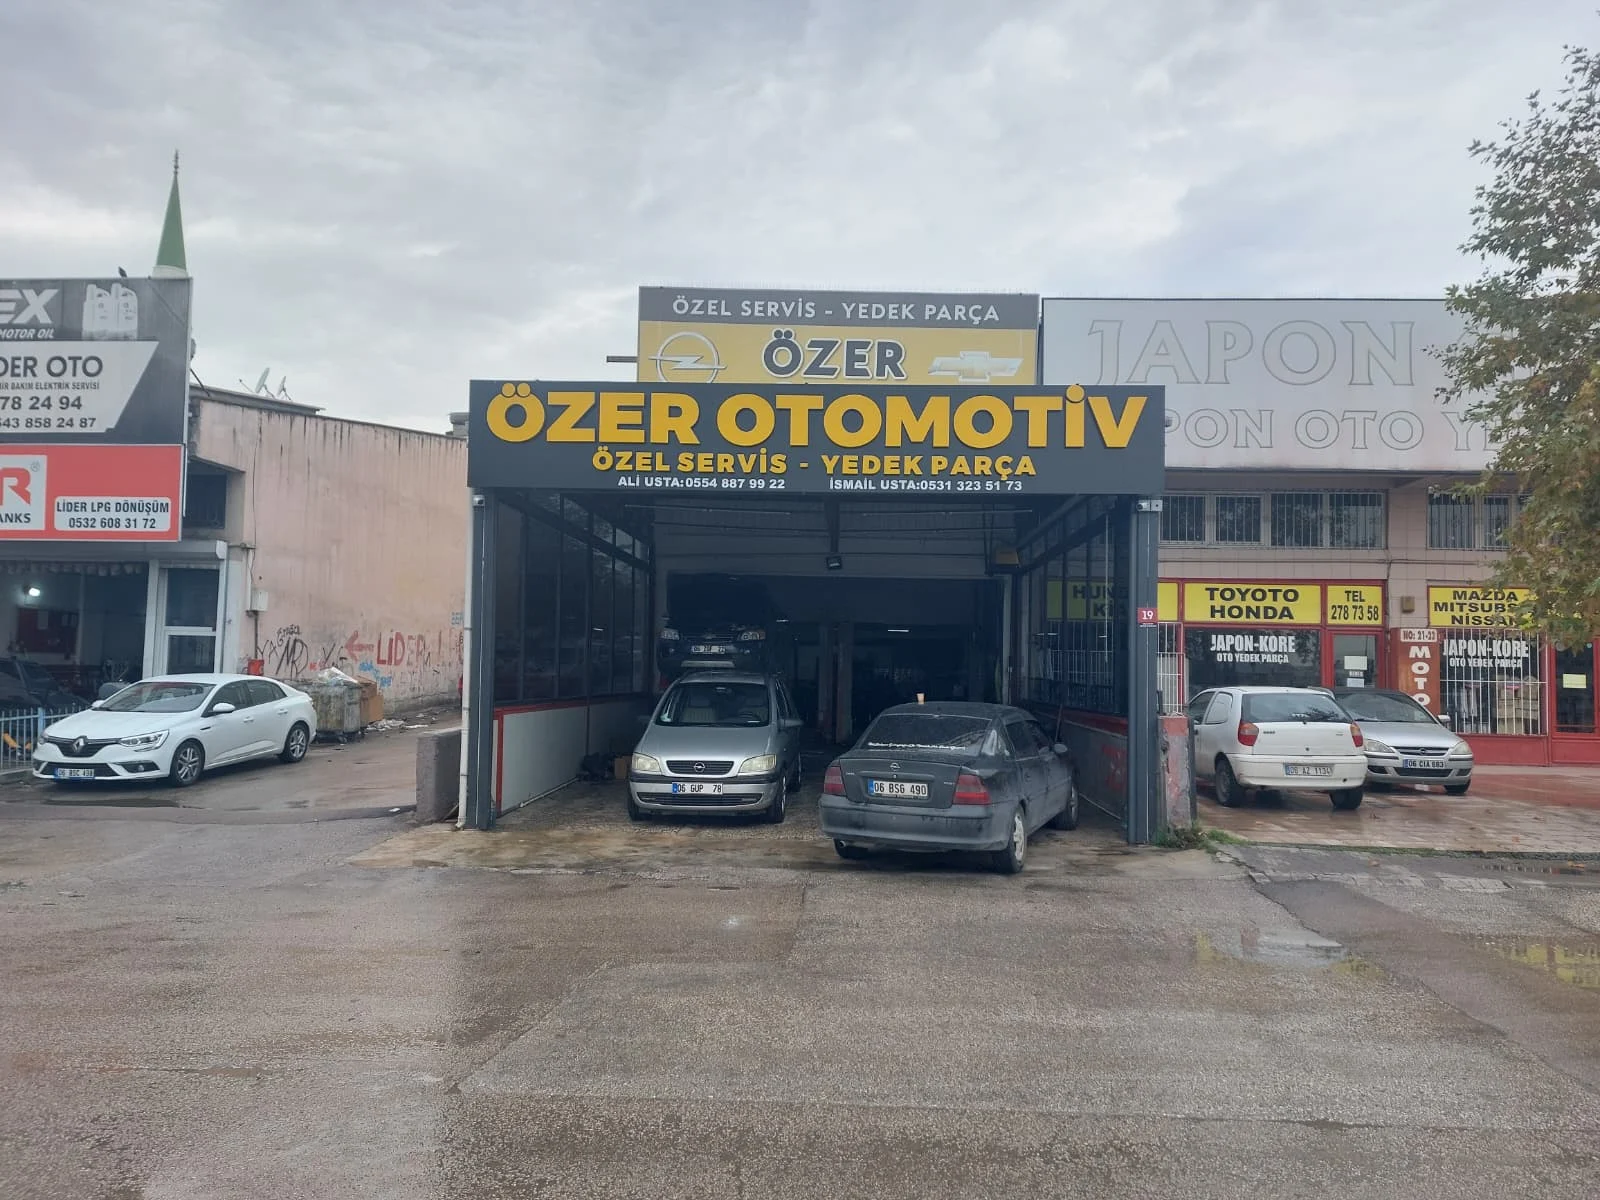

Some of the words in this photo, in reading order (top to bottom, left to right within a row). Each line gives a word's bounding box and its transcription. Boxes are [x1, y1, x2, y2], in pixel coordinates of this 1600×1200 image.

[672, 295, 732, 316] ÖZEL
[740, 297, 816, 319] SERVİS
[841, 302, 916, 321] YEDEK
[924, 304, 1000, 325] PARÇA
[762, 328, 907, 381] ÖZER
[1088, 320, 1415, 386] JAPON
[46, 355, 103, 377] OTO
[28, 396, 52, 410] 24
[59, 396, 82, 410] 94
[25, 417, 52, 428] 858
[56, 417, 74, 428] 24
[79, 417, 97, 428] 87
[486, 382, 701, 445] ÖZER
[716, 384, 1148, 449] OTOMOTİV
[1295, 408, 1425, 450] OTO
[592, 446, 671, 472] ÖZEL
[676, 447, 787, 474] SERVİS
[821, 455, 924, 476] YEDEK
[931, 455, 1037, 481] PARÇA
[617, 475, 640, 487] ALİ
[721, 478, 745, 489] 887
[749, 478, 765, 489] 99
[769, 479, 785, 489] 22
[829, 476, 876, 490] İSMAİL
[956, 480, 981, 491] 323
[985, 480, 1000, 491] 51
[1006, 480, 1022, 491] 73
[57, 500, 87, 513] LİDER
[91, 502, 111, 513] LPG
[115, 499, 169, 515] DÖNÜŞÜM
[68, 518, 96, 528] 0532
[100, 518, 121, 529] 608
[125, 518, 137, 529] 31
[142, 518, 156, 529] 72
[1205, 587, 1299, 602] TOYOTO
[1344, 590, 1365, 602] TEL
[1452, 590, 1518, 601] MAZDA
[1142, 610, 1154, 620] 19
[1210, 604, 1294, 619] HONDA
[1331, 604, 1349, 620] 278
[1352, 605, 1364, 620] 73
[1367, 605, 1379, 621] 58
[1210, 634, 1296, 653] JAPON-KORE
[1443, 639, 1529, 658] JAPON-KORE
[1217, 652, 1233, 662] OTO
[1235, 653, 1260, 663] YEDEK
[1261, 653, 1289, 664] PARÇA
[1449, 658, 1466, 667] OTO
[678, 783, 686, 793] 06
[690, 784, 704, 793] GUP
[712, 784, 722, 793] 78
[874, 782, 885, 792] 06
[888, 783, 905, 794] BSG
[910, 784, 927, 795] 490
